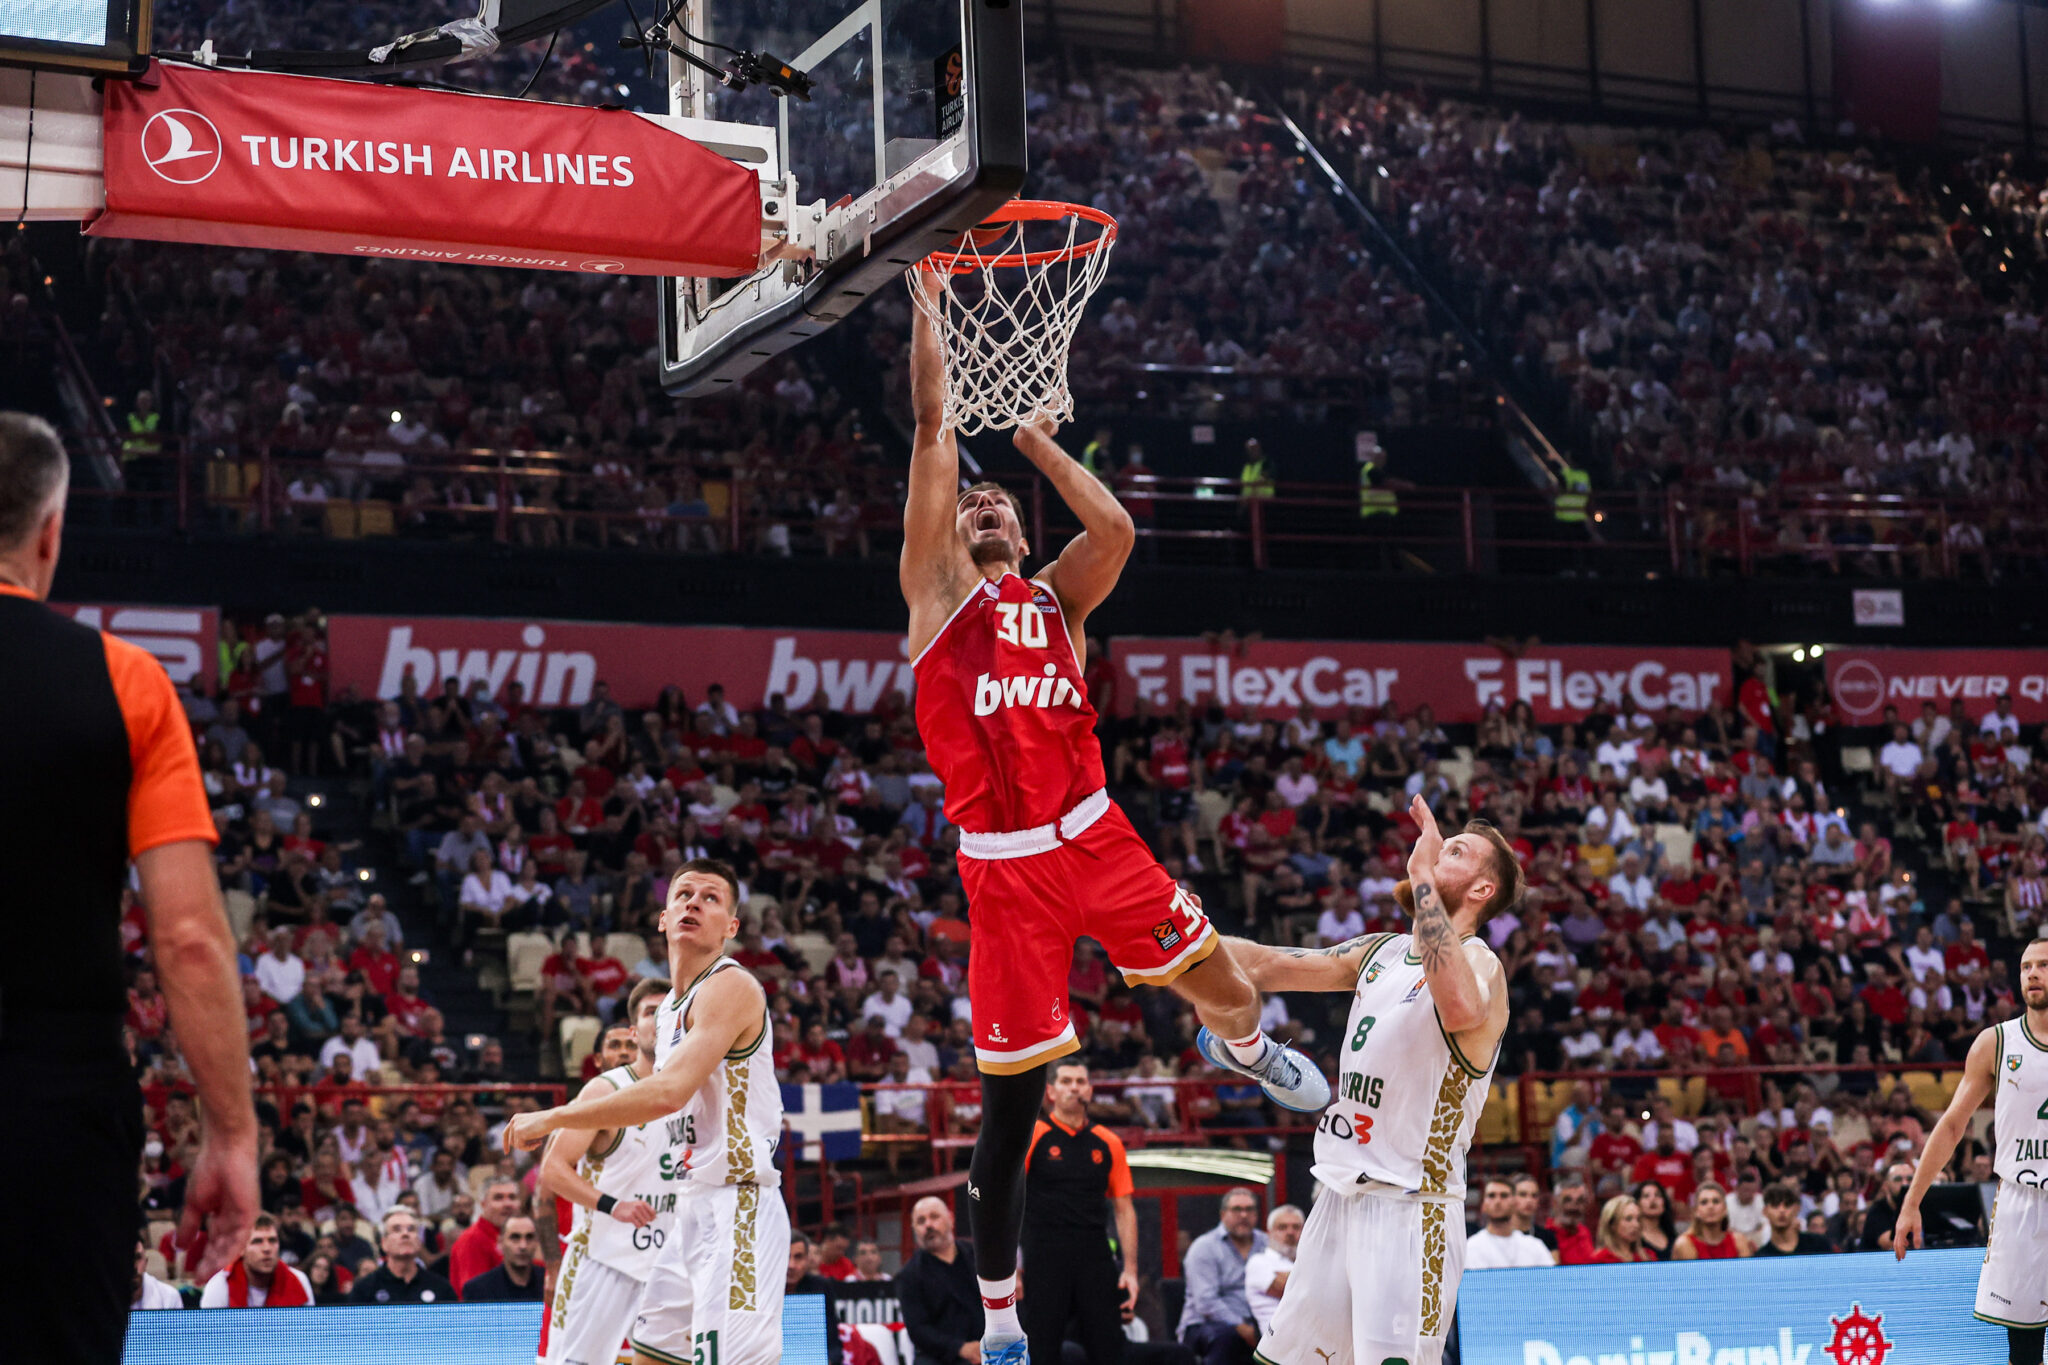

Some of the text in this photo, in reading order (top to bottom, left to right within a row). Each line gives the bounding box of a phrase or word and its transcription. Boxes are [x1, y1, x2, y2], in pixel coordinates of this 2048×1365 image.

[942, 95, 964, 118] TURKIS
[241, 134, 635, 187] TURKISH AIRLINES
[354, 245, 569, 267] TURKISH AIRLINES
[994, 602, 1049, 648] 30
[377, 624, 597, 705] bwin
[763, 636, 918, 712] bwi
[974, 662, 1082, 716] bwin
[1180, 655, 1399, 706] FlexCar
[1516, 659, 1720, 710] FlexCar
[1888, 675, 2010, 699] NEVER
[1351, 1016, 1376, 1051] 8
